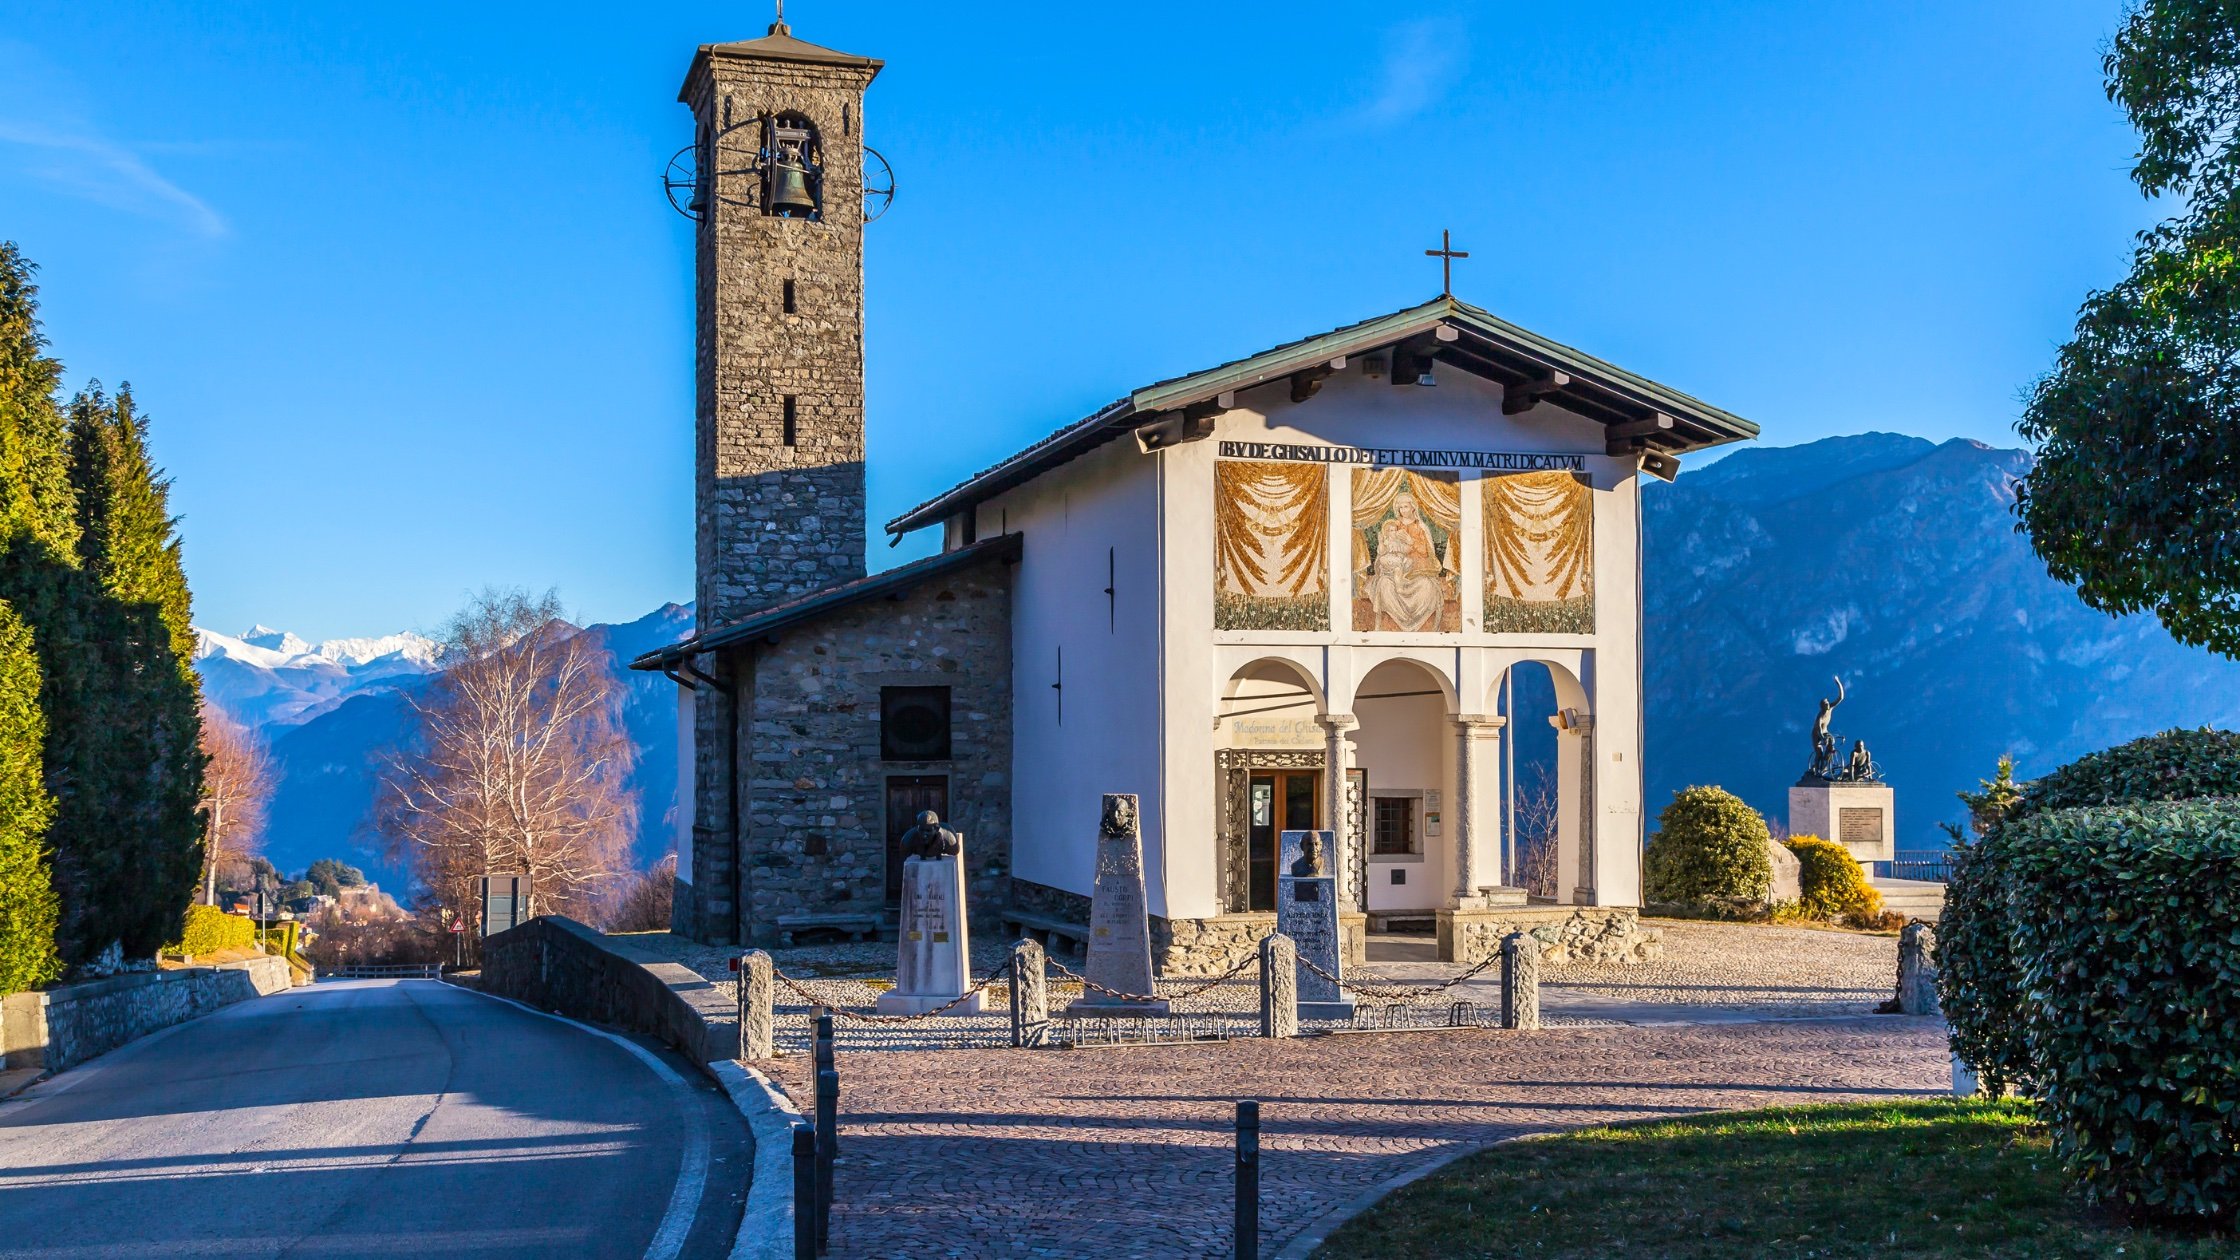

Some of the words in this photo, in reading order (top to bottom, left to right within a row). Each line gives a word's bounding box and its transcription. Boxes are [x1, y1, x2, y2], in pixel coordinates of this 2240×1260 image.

[1378, 450, 1399, 464] ET
[1403, 450, 1473, 466] HOMINVM
[1473, 453, 1520, 468] MATRI
[1520, 455, 1582, 470] DICATVM
[1233, 720, 1276, 734] Madonna
[1279, 720, 1292, 733] del
